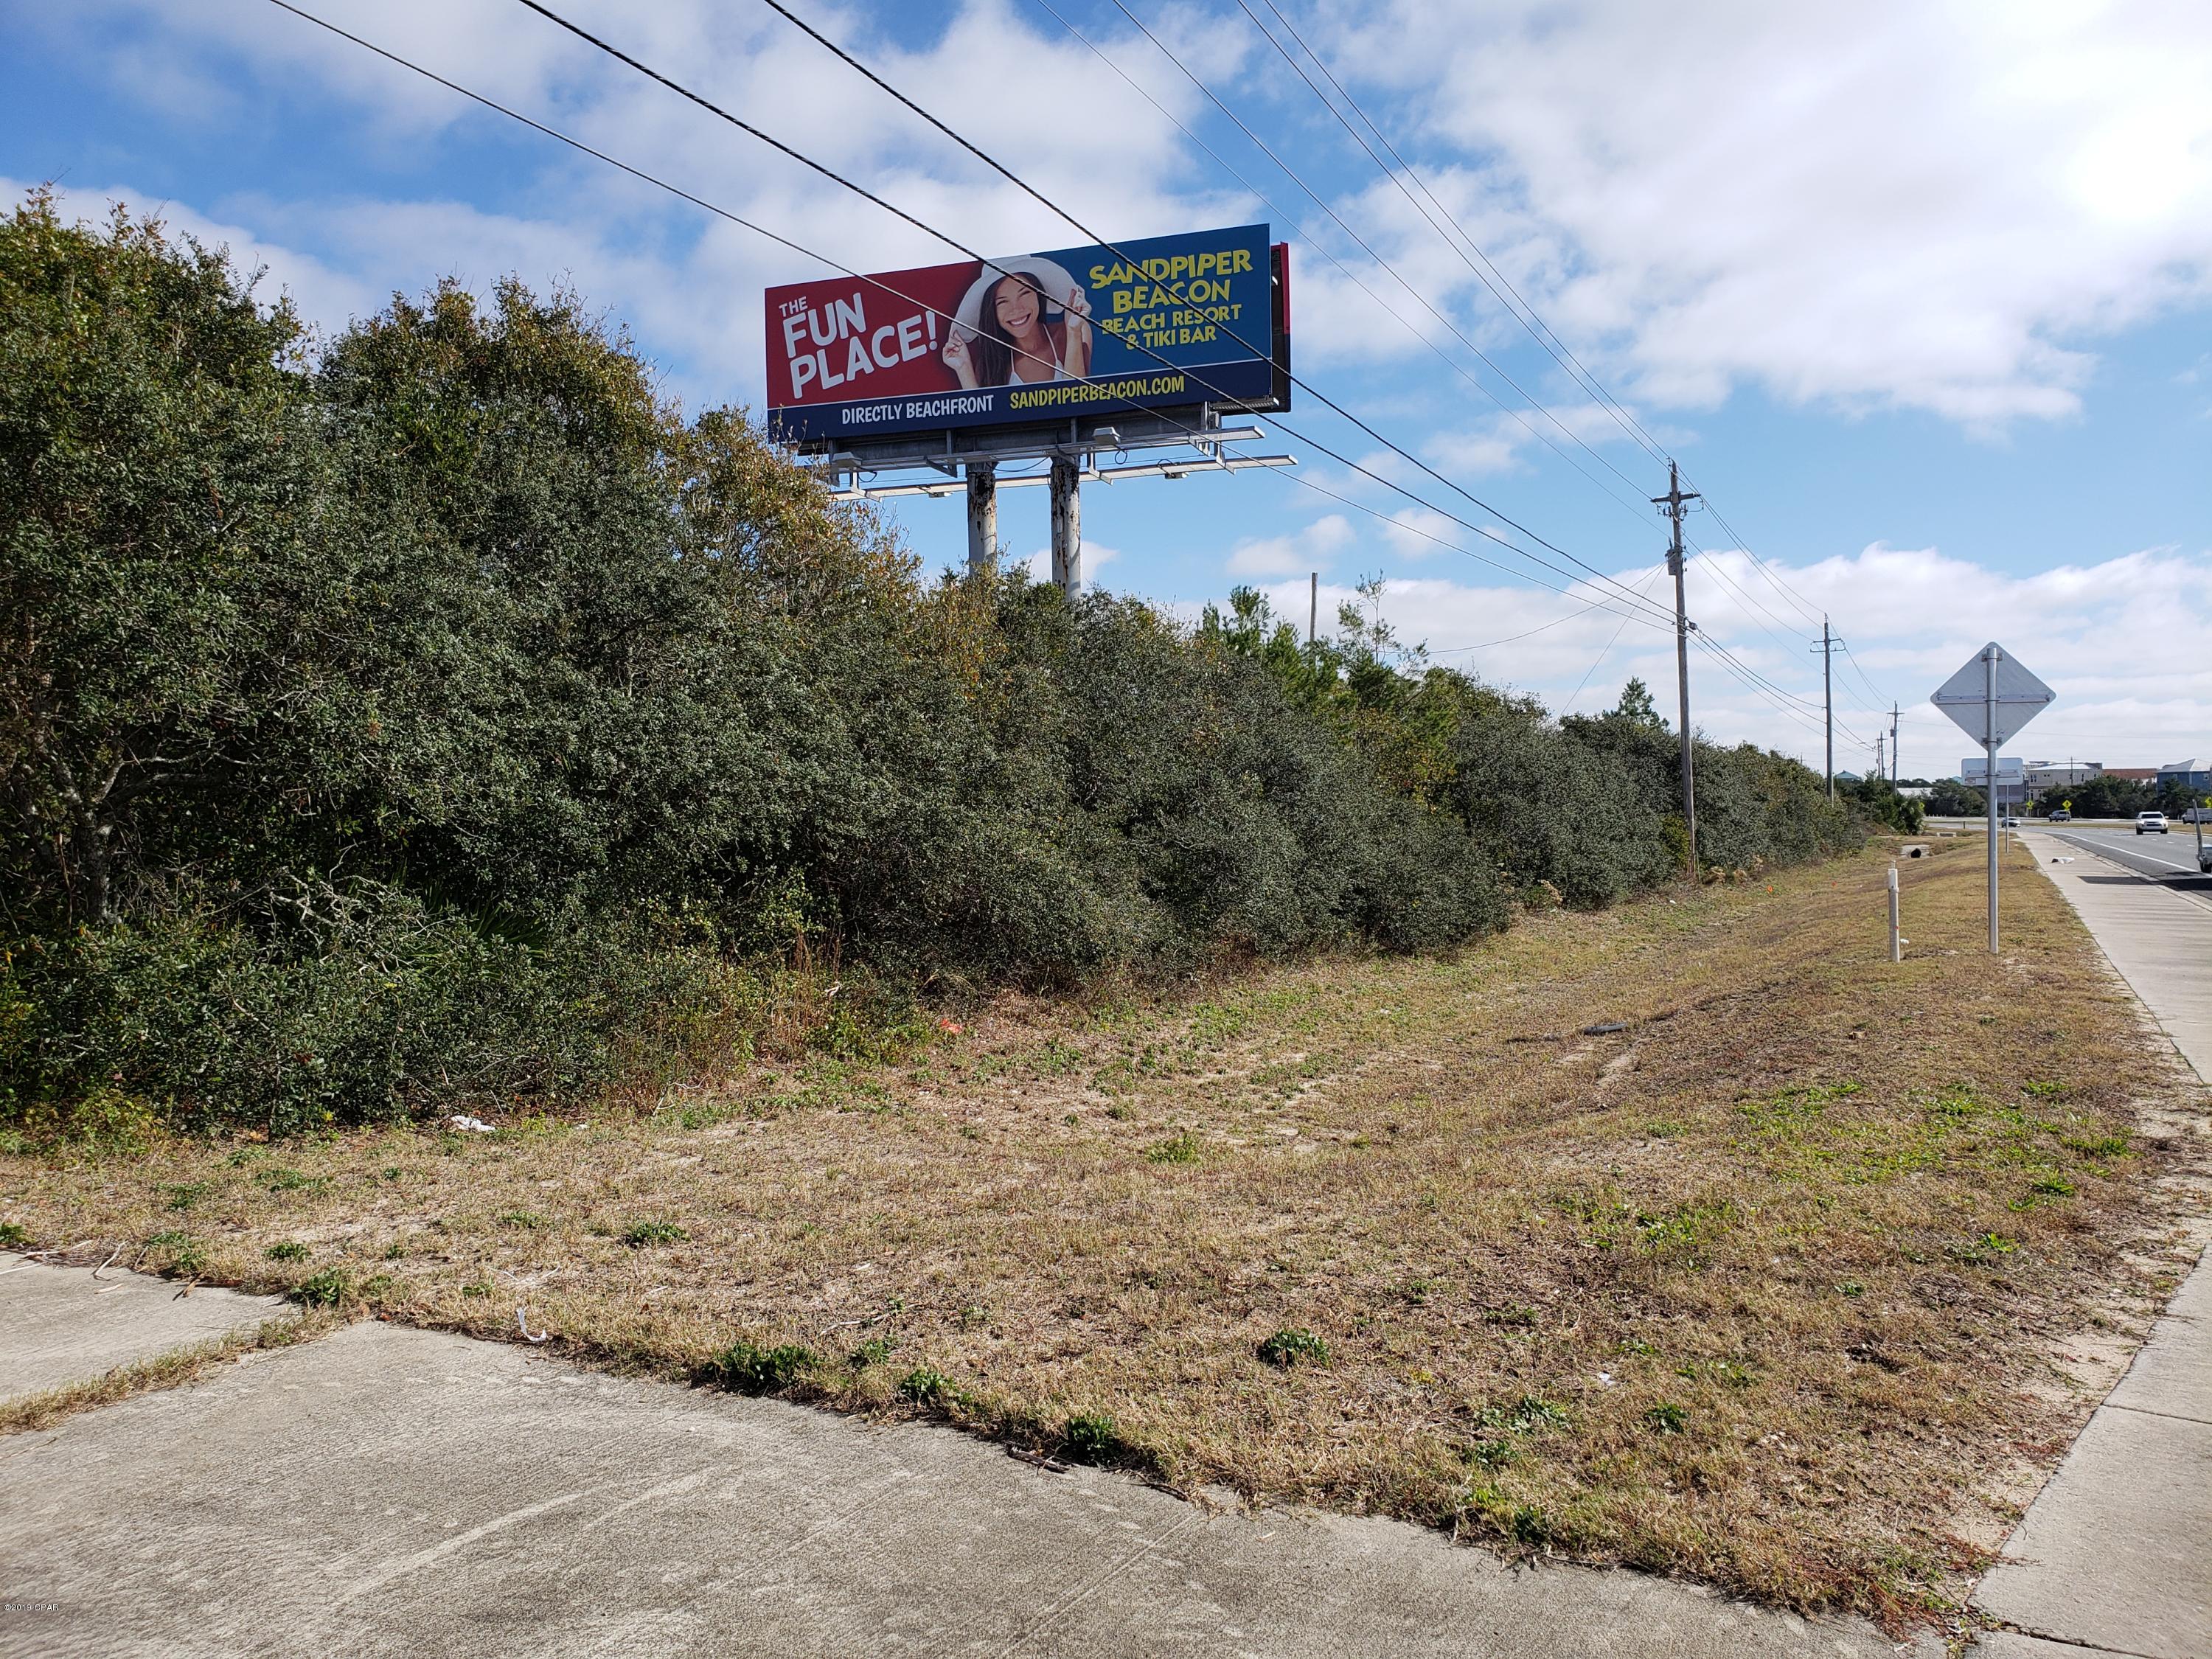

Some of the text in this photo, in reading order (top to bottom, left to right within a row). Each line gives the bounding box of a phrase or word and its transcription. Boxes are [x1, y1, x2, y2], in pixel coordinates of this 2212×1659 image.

[1089, 249, 1253, 289] SANDPIPER
[779, 296, 808, 317] THE
[1113, 279, 1231, 314] BEACON
[783, 292, 866, 358] FUN
[1102, 304, 1242, 335] BEACH RESORT
[790, 310, 938, 399] PLACE!
[1125, 325, 1217, 350] & TIKI BAR
[1009, 375, 1185, 409] SANDPIPERBEACON.COM
[842, 394, 994, 425] DIRECTLY BEACHFRONT
